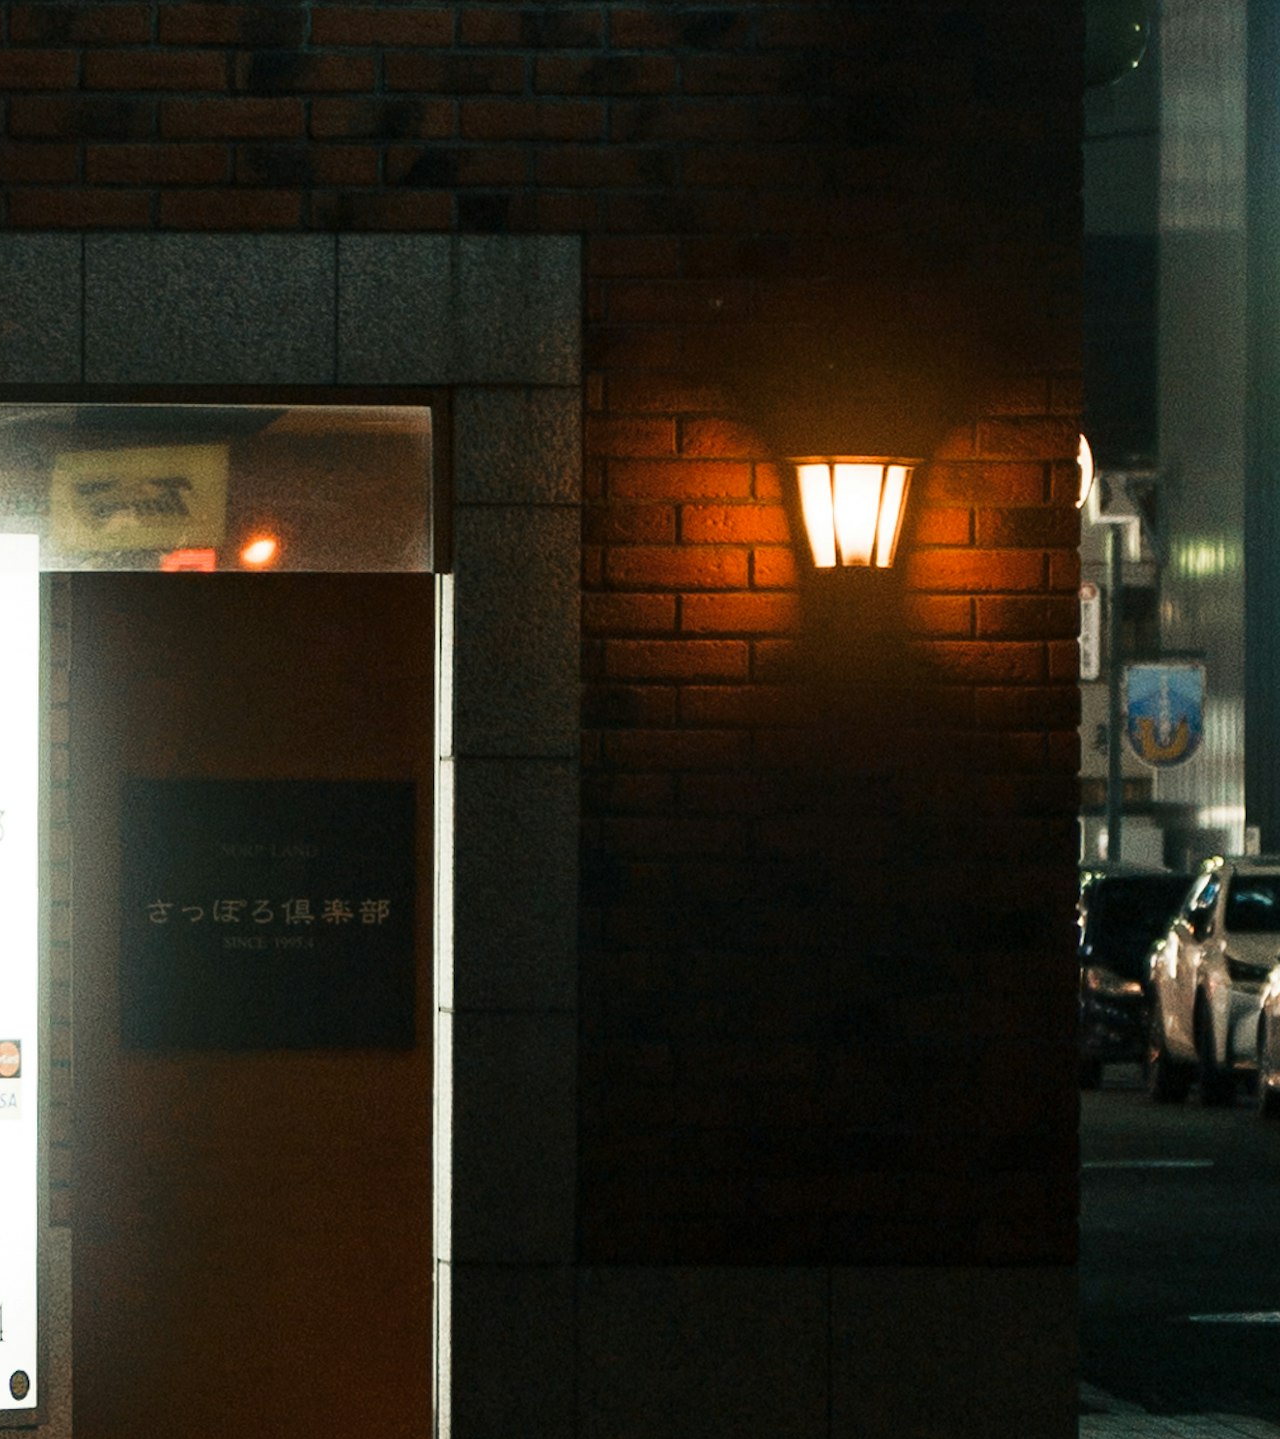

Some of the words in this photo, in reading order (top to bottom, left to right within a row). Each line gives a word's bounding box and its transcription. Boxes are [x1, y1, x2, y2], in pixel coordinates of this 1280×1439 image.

[270, 843, 319, 859] LAND
[146, 897, 392, 927] さっぽろ倶楽部
[222, 935, 266, 950] SINCE
